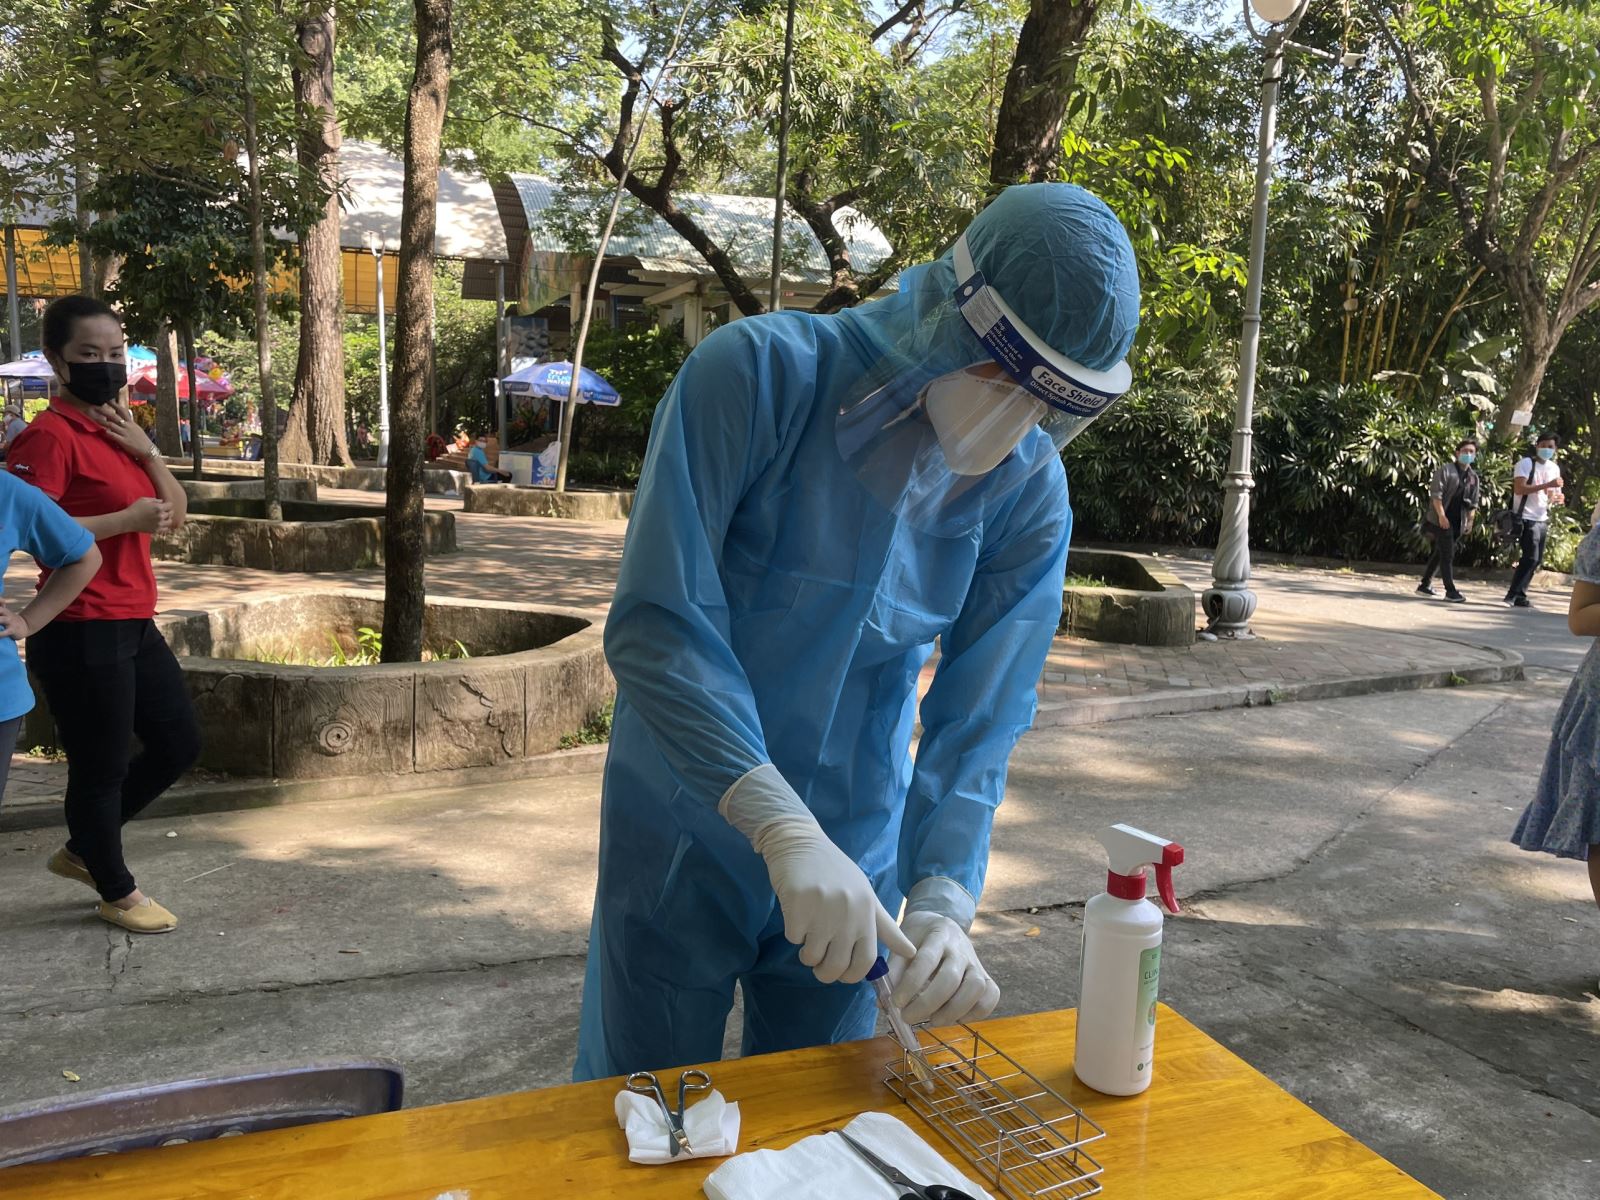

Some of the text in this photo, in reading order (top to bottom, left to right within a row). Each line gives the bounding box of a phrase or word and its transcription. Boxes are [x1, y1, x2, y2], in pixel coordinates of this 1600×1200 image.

[985, 334, 1020, 373] from overflowing
[993, 326, 1003, 337] only
[1002, 335, 1008, 343] be
[1007, 343, 1019, 354] used
[1008, 352, 1017, 361] the
[1030, 380, 1092, 413] Direct Splash Protection
[1038, 370, 1103, 406] Face Shield
